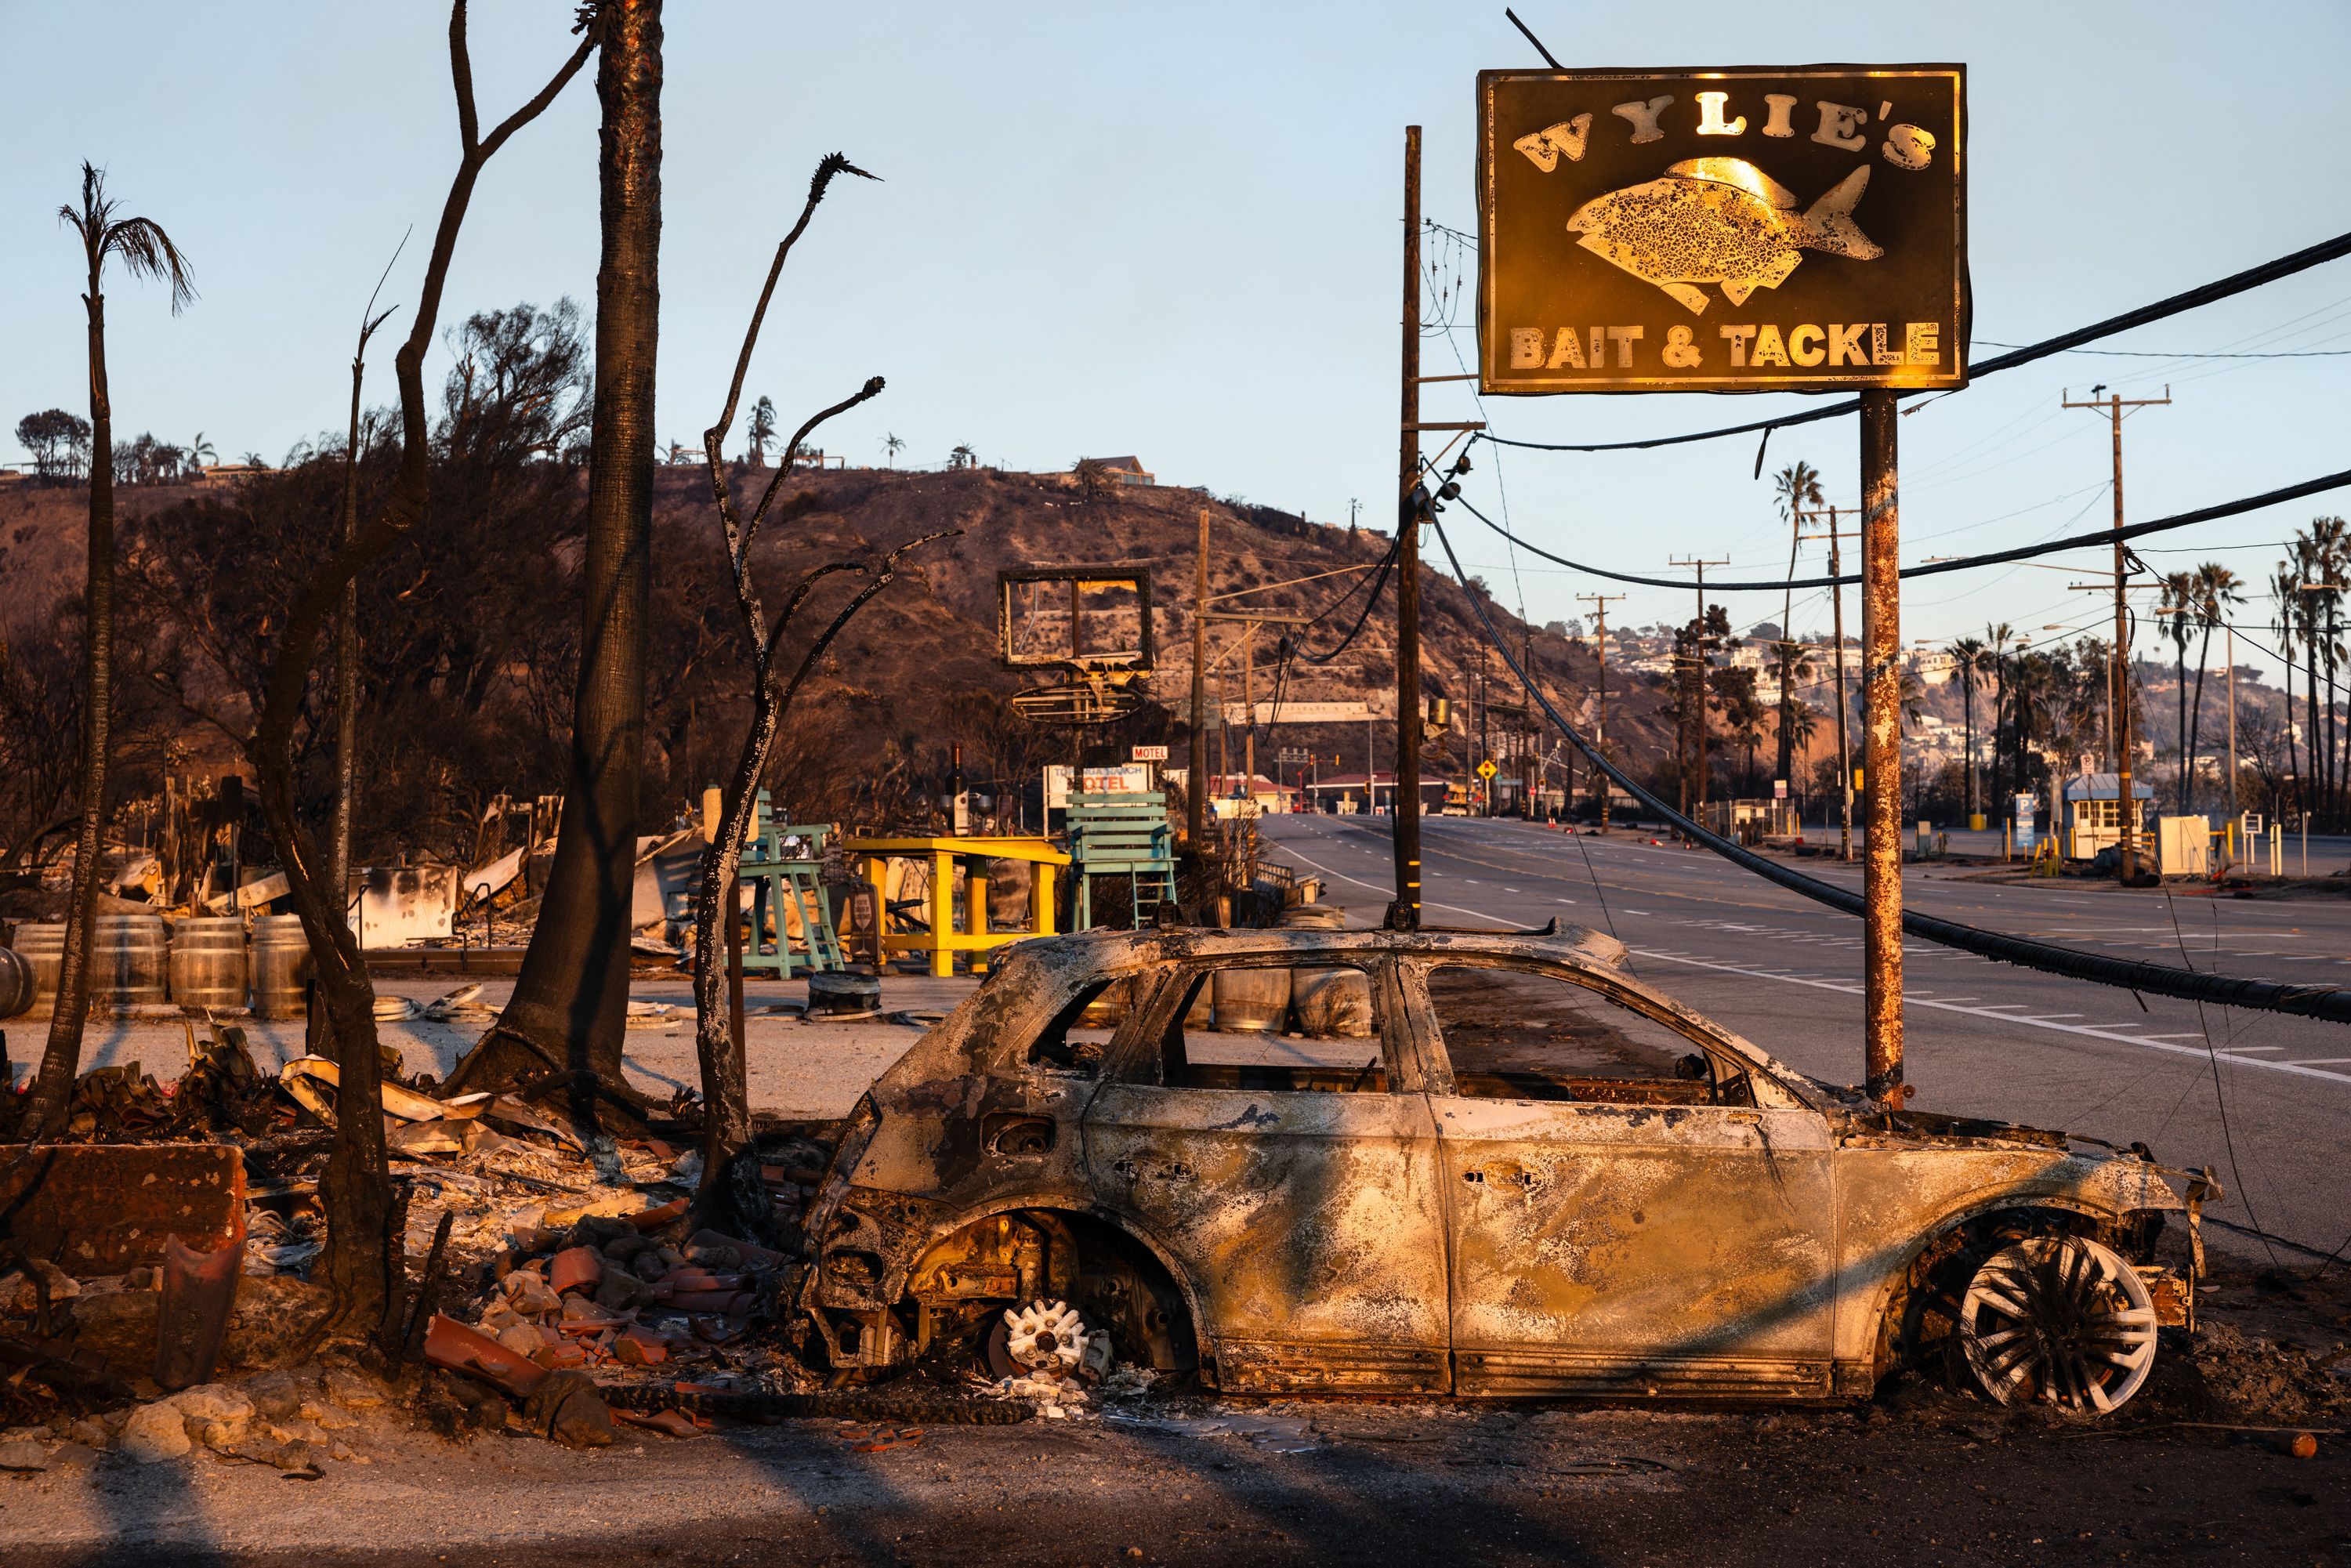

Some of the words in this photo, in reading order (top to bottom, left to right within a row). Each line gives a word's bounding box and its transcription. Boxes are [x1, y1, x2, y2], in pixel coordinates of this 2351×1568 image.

[1513, 91, 1936, 172] WYLIE'S
[1509, 325, 1643, 370] BAIT
[1666, 324, 1703, 368] &
[1719, 322, 1940, 367] TACKLE
[1135, 748, 1166, 758] MOTEL
[1054, 767, 1103, 777] TOPNGA
